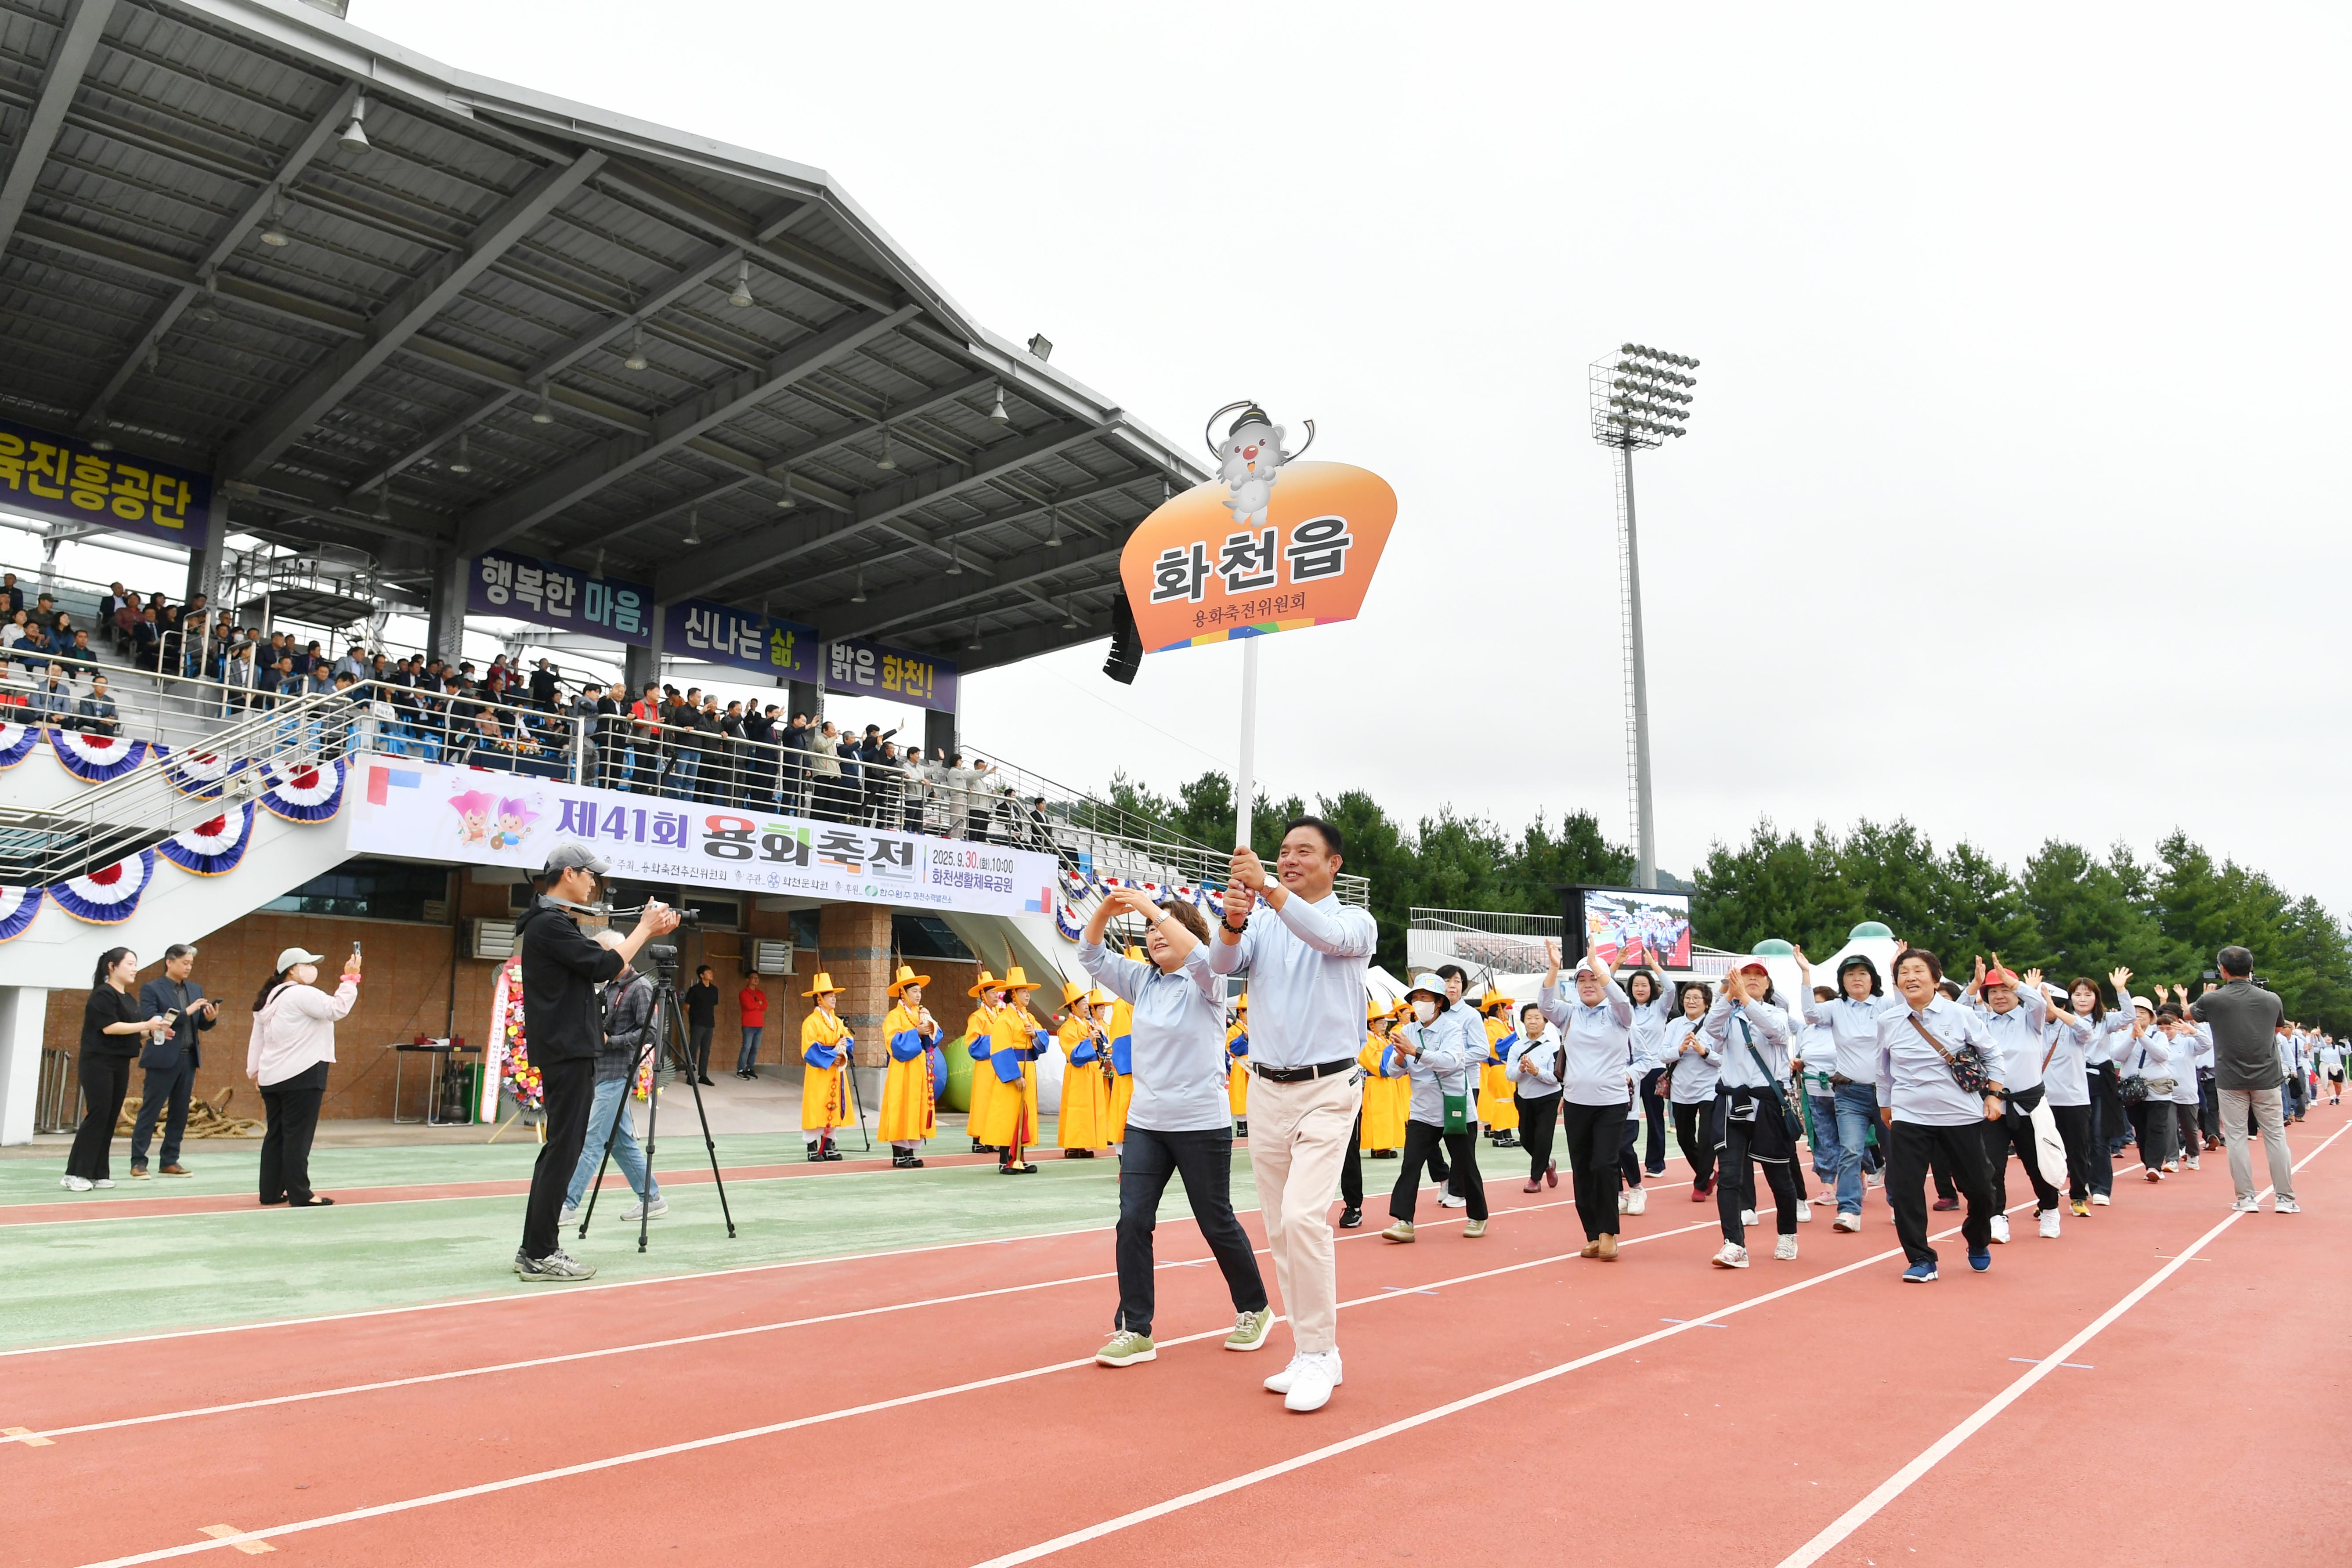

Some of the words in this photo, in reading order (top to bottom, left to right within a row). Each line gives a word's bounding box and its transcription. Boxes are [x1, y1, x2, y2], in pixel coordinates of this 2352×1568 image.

[1153, 519, 1350, 600] 화천읍
[482, 556, 576, 618] 행복한
[585, 582, 648, 637] 마음,
[1192, 592, 1306, 628] 용화축전위원회
[685, 607, 762, 660] 신나는
[770, 628, 800, 671] 삶,
[831, 643, 875, 686] 밝은
[882, 654, 933, 699] 화천!
[555, 798, 688, 848] 제41회
[702, 815, 914, 880] 용화축전
[642, 861, 727, 881] 용화축전추진위원회
[782, 877, 828, 890] 화천문화원
[932, 868, 1013, 893] 화천생활체육공원
[913, 892, 952, 904] 화천수력발전소
